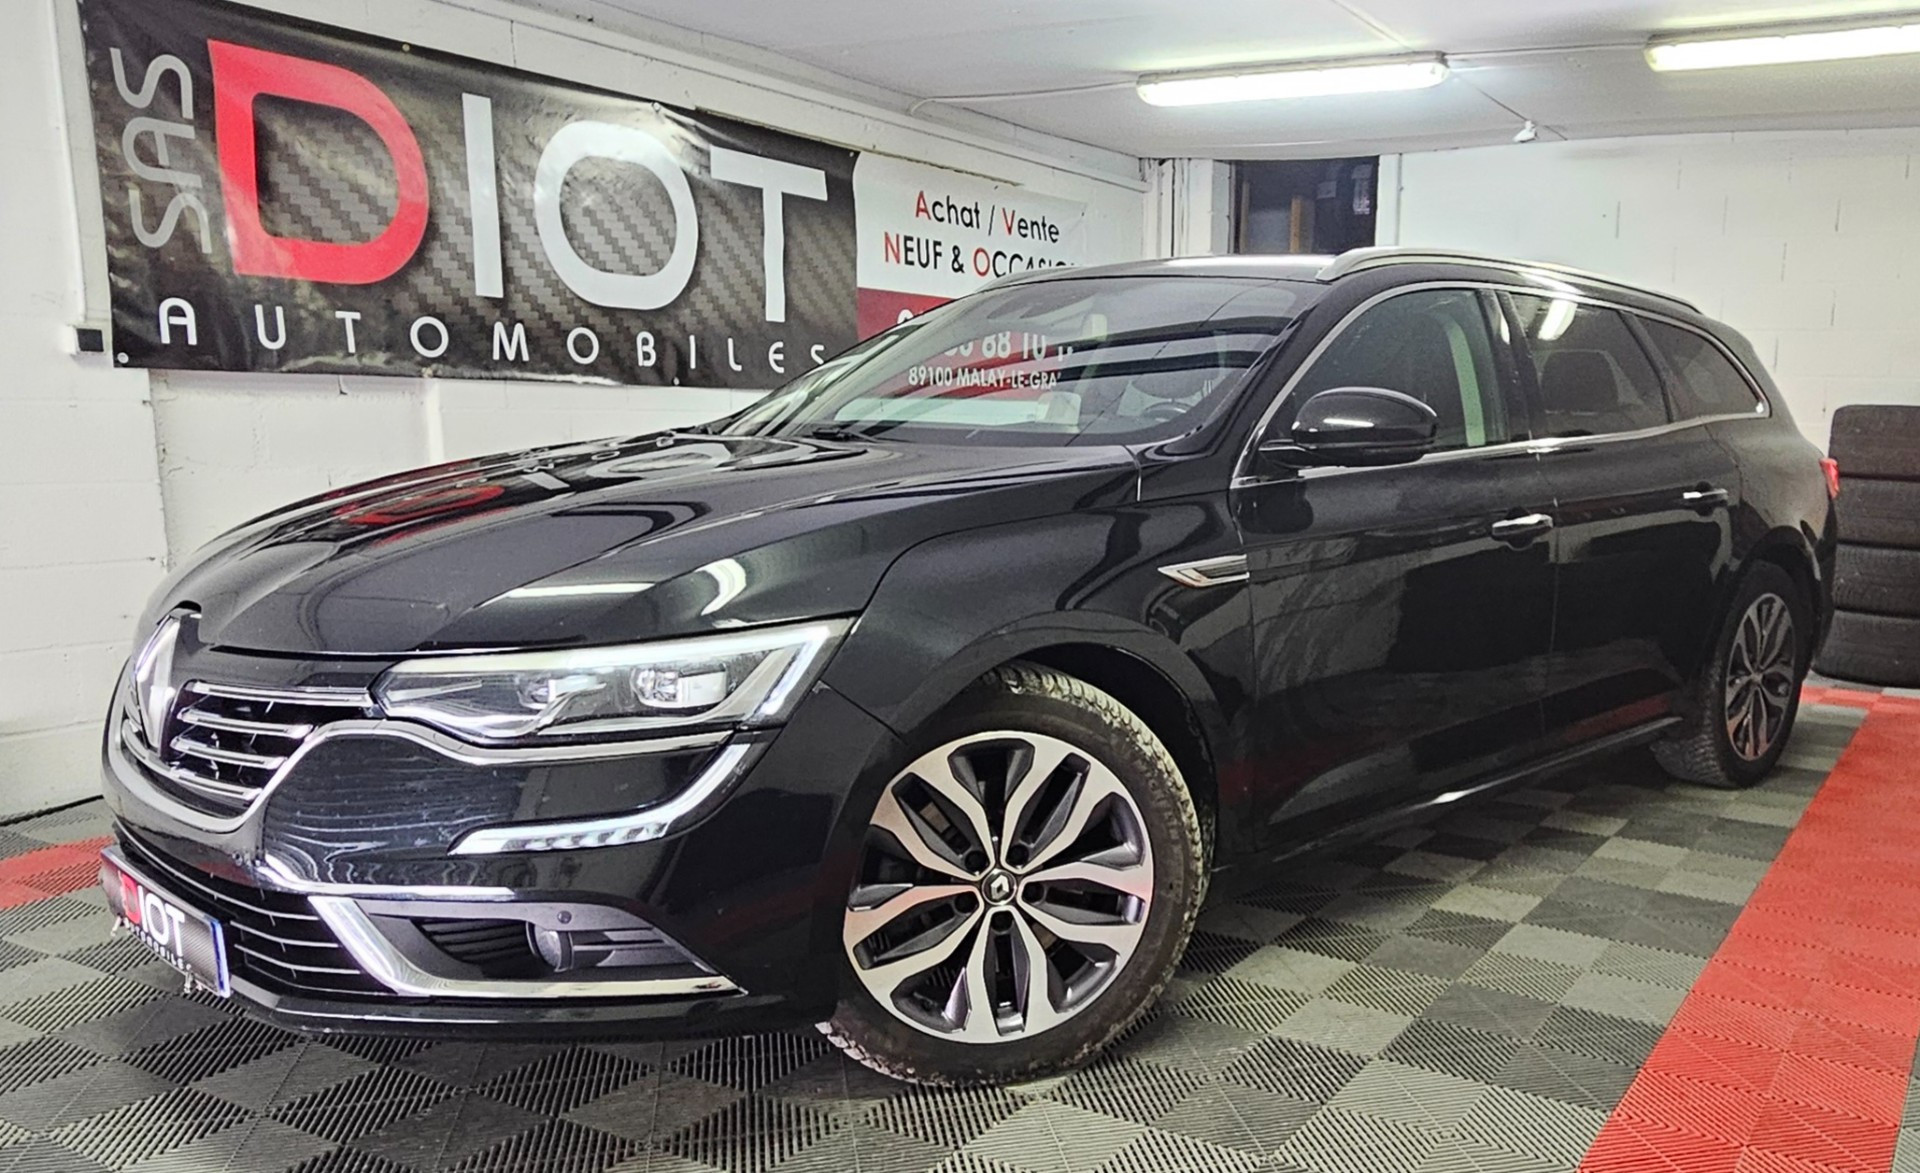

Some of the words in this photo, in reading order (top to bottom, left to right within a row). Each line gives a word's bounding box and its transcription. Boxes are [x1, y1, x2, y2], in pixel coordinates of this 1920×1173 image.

[109, 47, 212, 254] SAS
[207, 39, 828, 323] DIOT
[884, 231, 943, 270] NEUF
[950, 245, 965, 275] &
[915, 190, 980, 230] Achat
[988, 205, 996, 236] /
[1002, 207, 1060, 243] Vente
[158, 297, 825, 374] AUTOMOBILES
[908, 365, 952, 386] 89100
[957, 367, 1061, 390] MALAY-LE-GRA
[121, 871, 185, 958] DIOT
